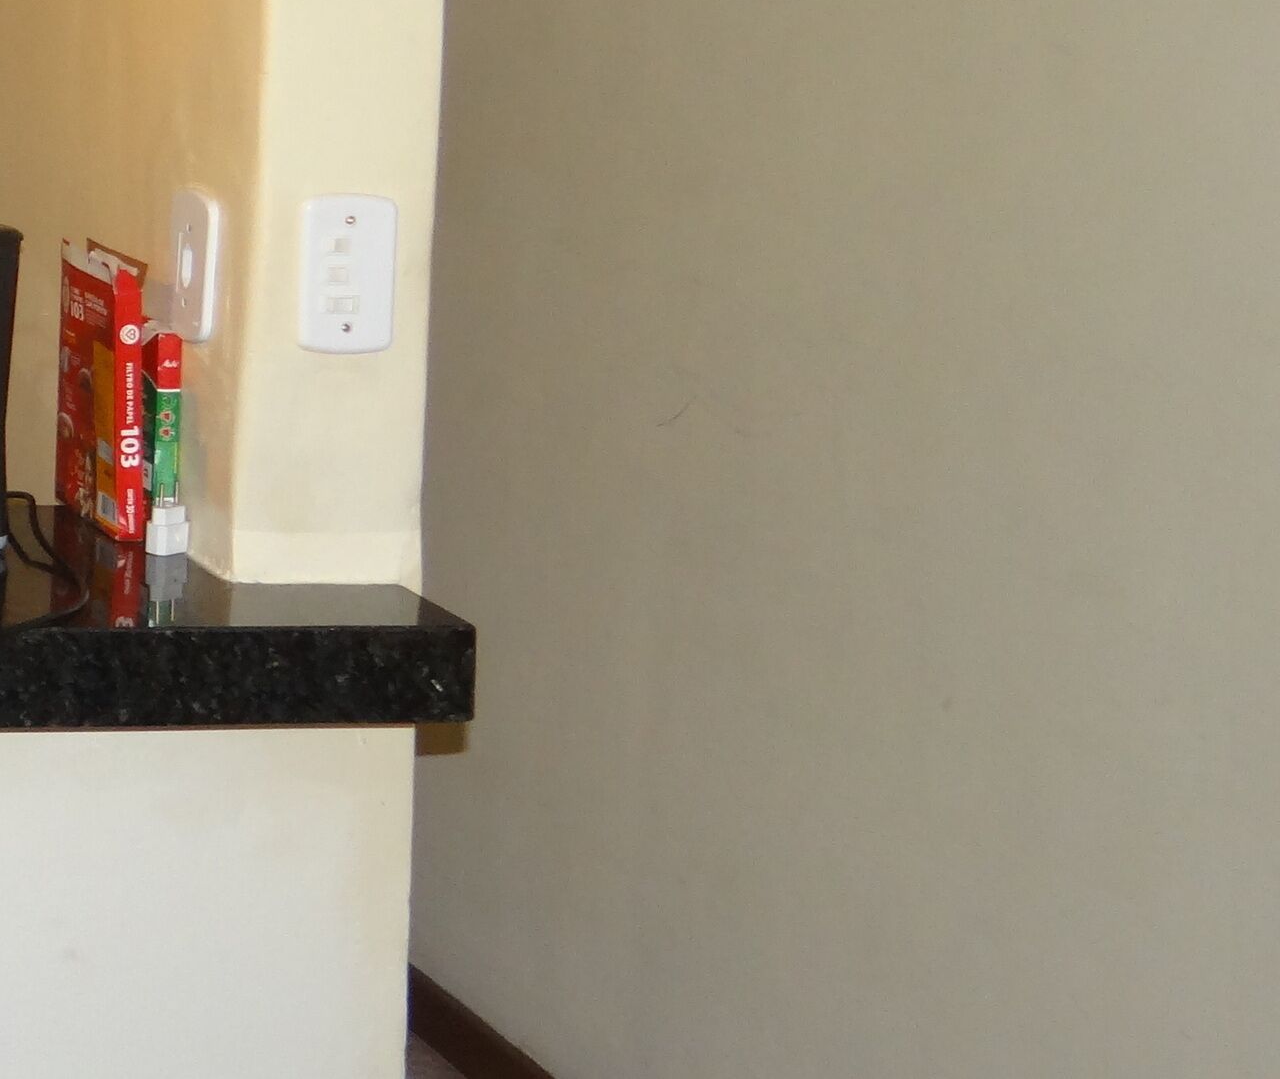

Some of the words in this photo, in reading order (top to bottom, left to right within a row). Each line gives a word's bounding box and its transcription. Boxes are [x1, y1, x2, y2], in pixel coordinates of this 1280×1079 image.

[71, 301, 83, 321] 103
[126, 362, 134, 388] FILTRO
[126, 389, 134, 400] DE
[126, 401, 134, 425] PAPEL
[120, 425, 140, 468] 103
